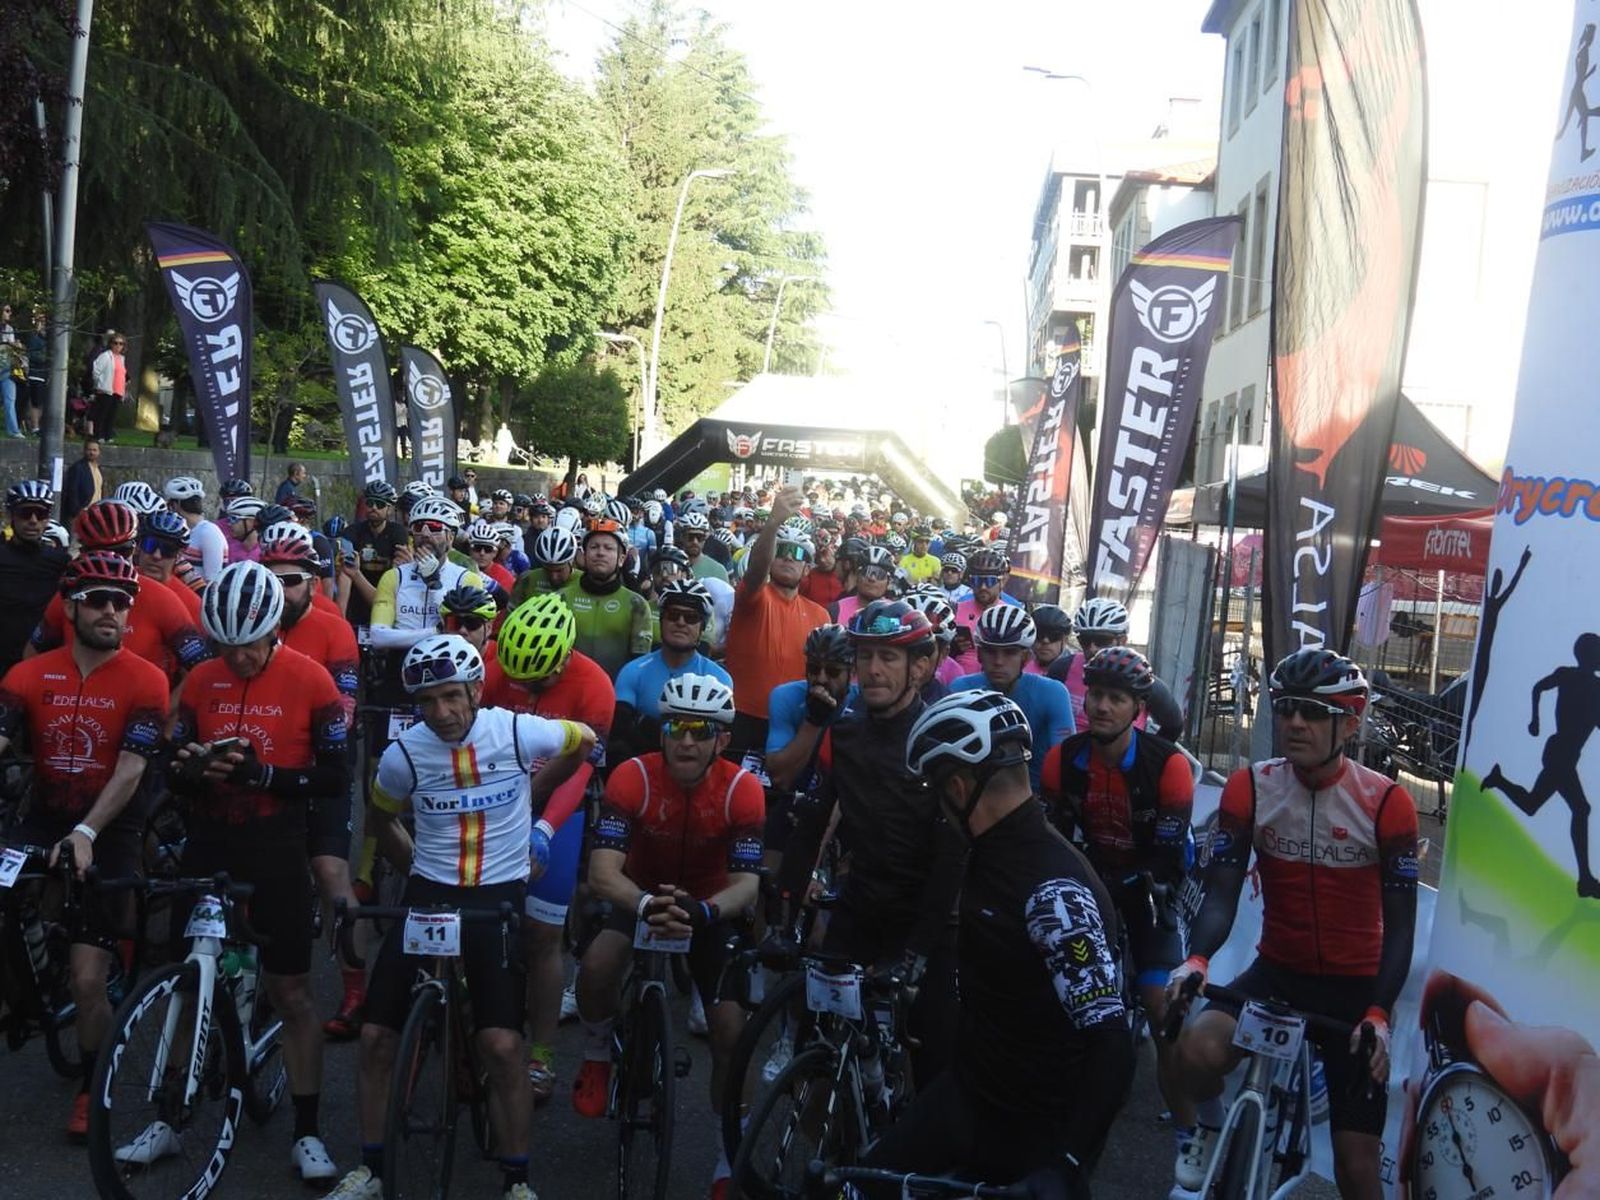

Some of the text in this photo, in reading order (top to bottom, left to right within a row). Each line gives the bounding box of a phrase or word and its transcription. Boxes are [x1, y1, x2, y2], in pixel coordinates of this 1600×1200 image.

[1093, 346, 1179, 591] FASTER
[1384, 476, 1478, 499] REK
[424, 926, 446, 941] 11
[829, 988, 842, 1002] 2
[1262, 1026, 1290, 1046] 10
[1464, 1096, 1475, 1112] 5
[1486, 1107, 1503, 1126] 10
[1508, 1134, 1526, 1152] 15
[1511, 1170, 1534, 1191] 20
